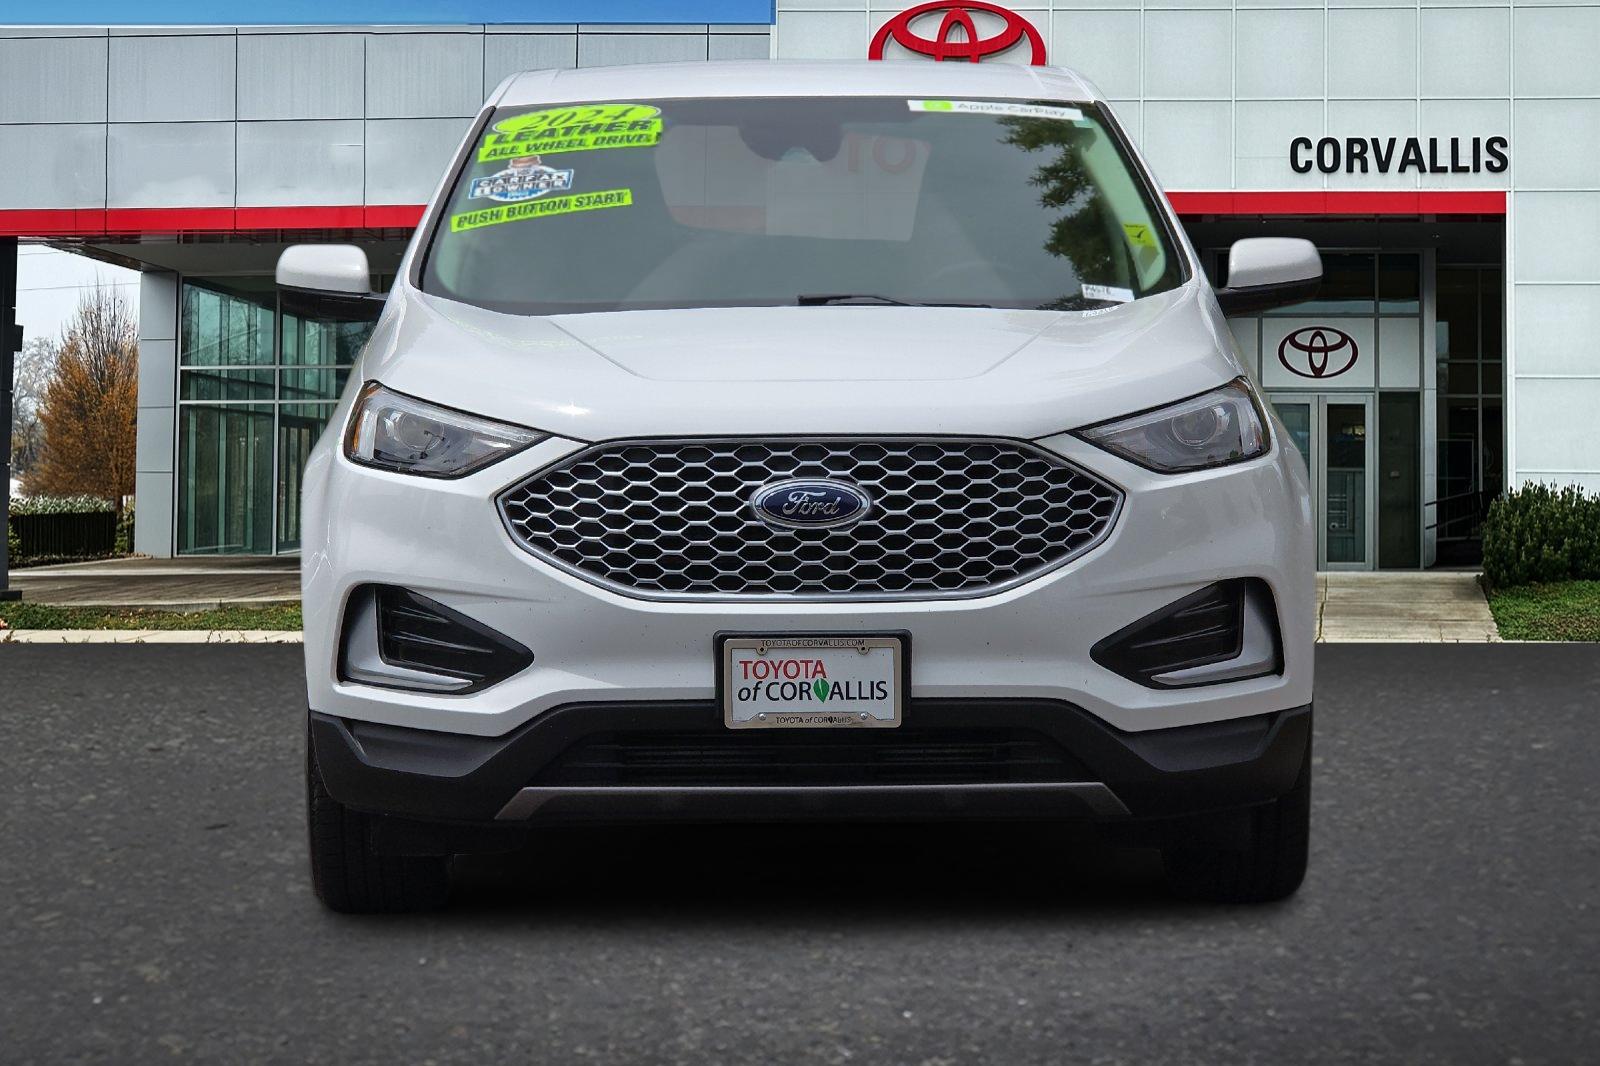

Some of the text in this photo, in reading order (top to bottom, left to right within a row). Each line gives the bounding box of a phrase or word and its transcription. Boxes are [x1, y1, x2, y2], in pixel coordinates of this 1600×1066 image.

[521, 105, 635, 132] 2024
[957, 103, 1066, 117] Apple CarPlay
[492, 119, 656, 145] LEATHER
[484, 131, 653, 158] ALL WHEEL DRIVE
[1289, 136, 1509, 173] CORVALLIS
[479, 172, 566, 187] CARFAX
[492, 181, 565, 194] OWNER
[456, 191, 627, 228] PUSH BUTTON START
[781, 490, 842, 515] Ford
[761, 639, 865, 647] TOYOTAOFCORVALLIS.COM
[739, 660, 827, 680] TOYOTA
[737, 681, 763, 702] of
[775, 716, 804, 724] TOYOTA
[805, 716, 813, 724] of
